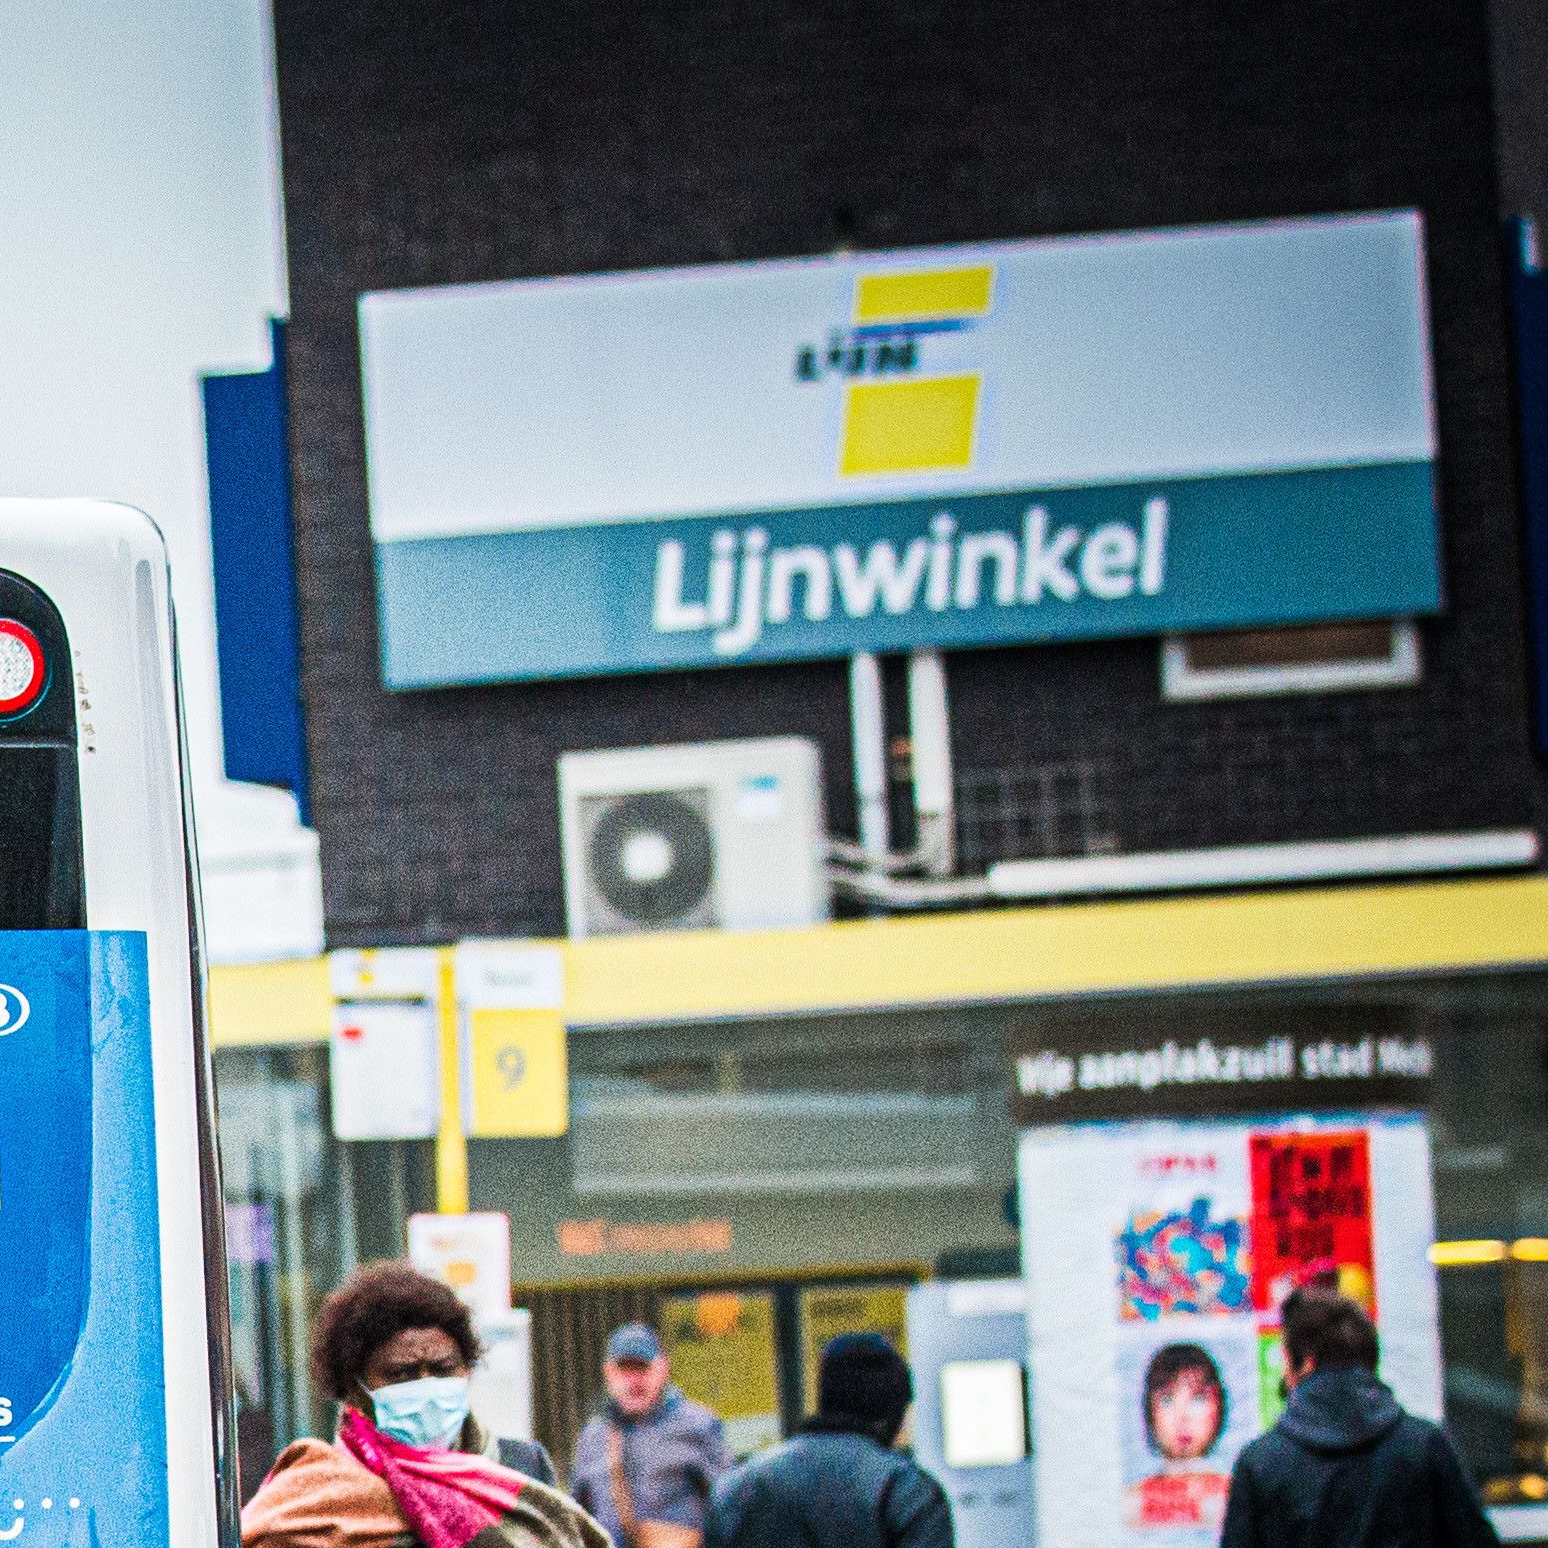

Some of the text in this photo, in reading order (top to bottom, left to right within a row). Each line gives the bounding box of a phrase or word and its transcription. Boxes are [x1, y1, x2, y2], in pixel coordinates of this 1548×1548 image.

[655, 496, 1169, 657] Lijnwinkel
[495, 1045, 526, 1092] 9
[1301, 1036, 1372, 1079] stad
